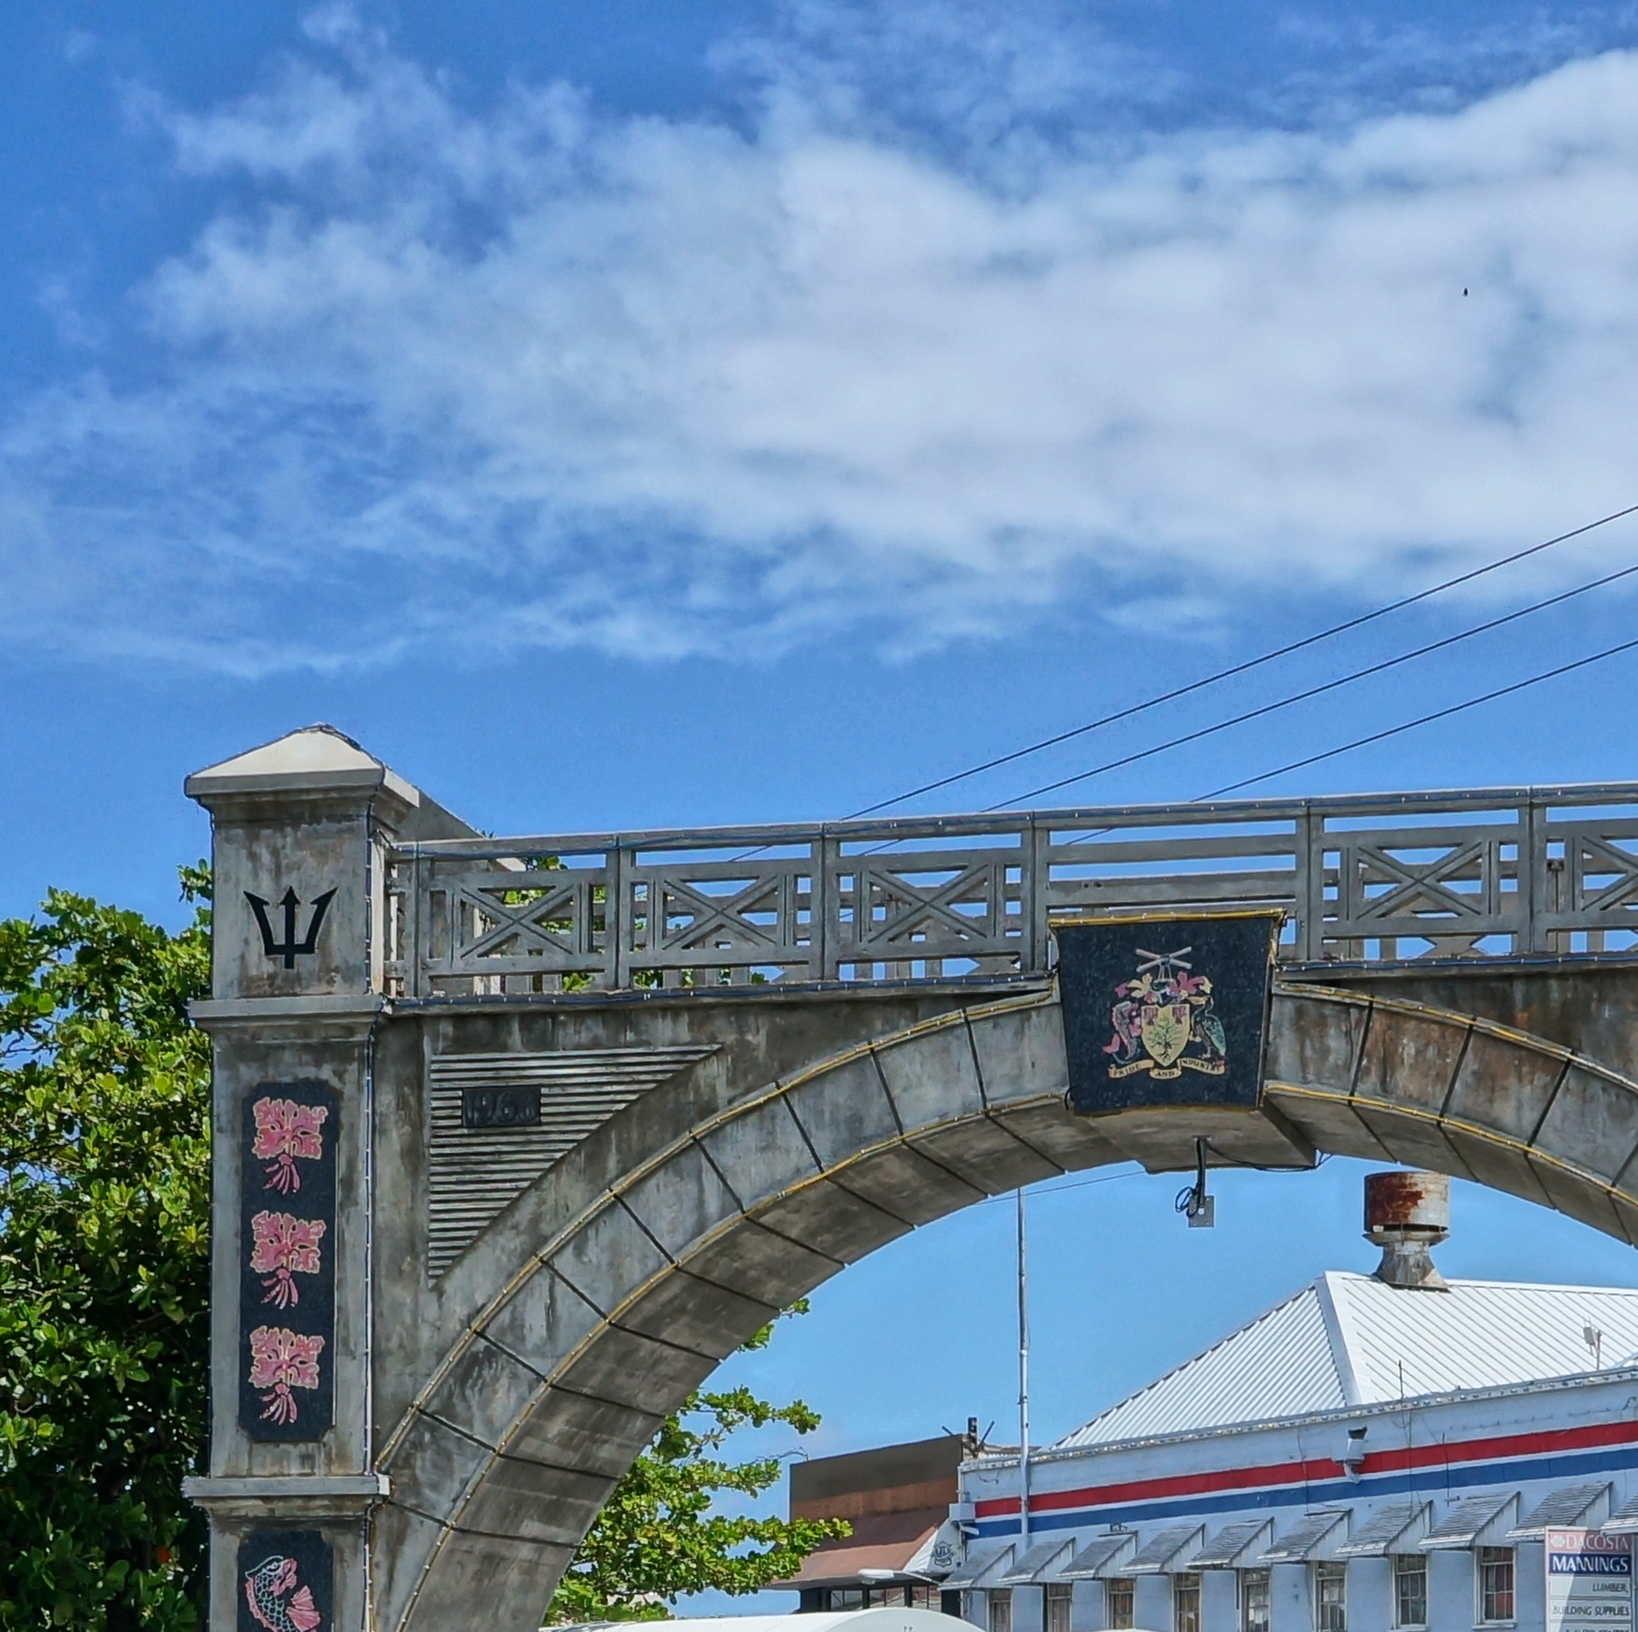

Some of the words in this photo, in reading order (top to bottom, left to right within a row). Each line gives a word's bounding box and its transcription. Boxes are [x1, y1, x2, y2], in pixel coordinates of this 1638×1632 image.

[1566, 1534, 1628, 1550] DACOSTA
[1552, 1555, 1628, 1572] MANNINGS
[1592, 1582, 1629, 1593] LUMBER,
[1552, 1605, 1592, 1616] BUILDING
[1594, 1606, 1630, 1617] SUPPLIES
